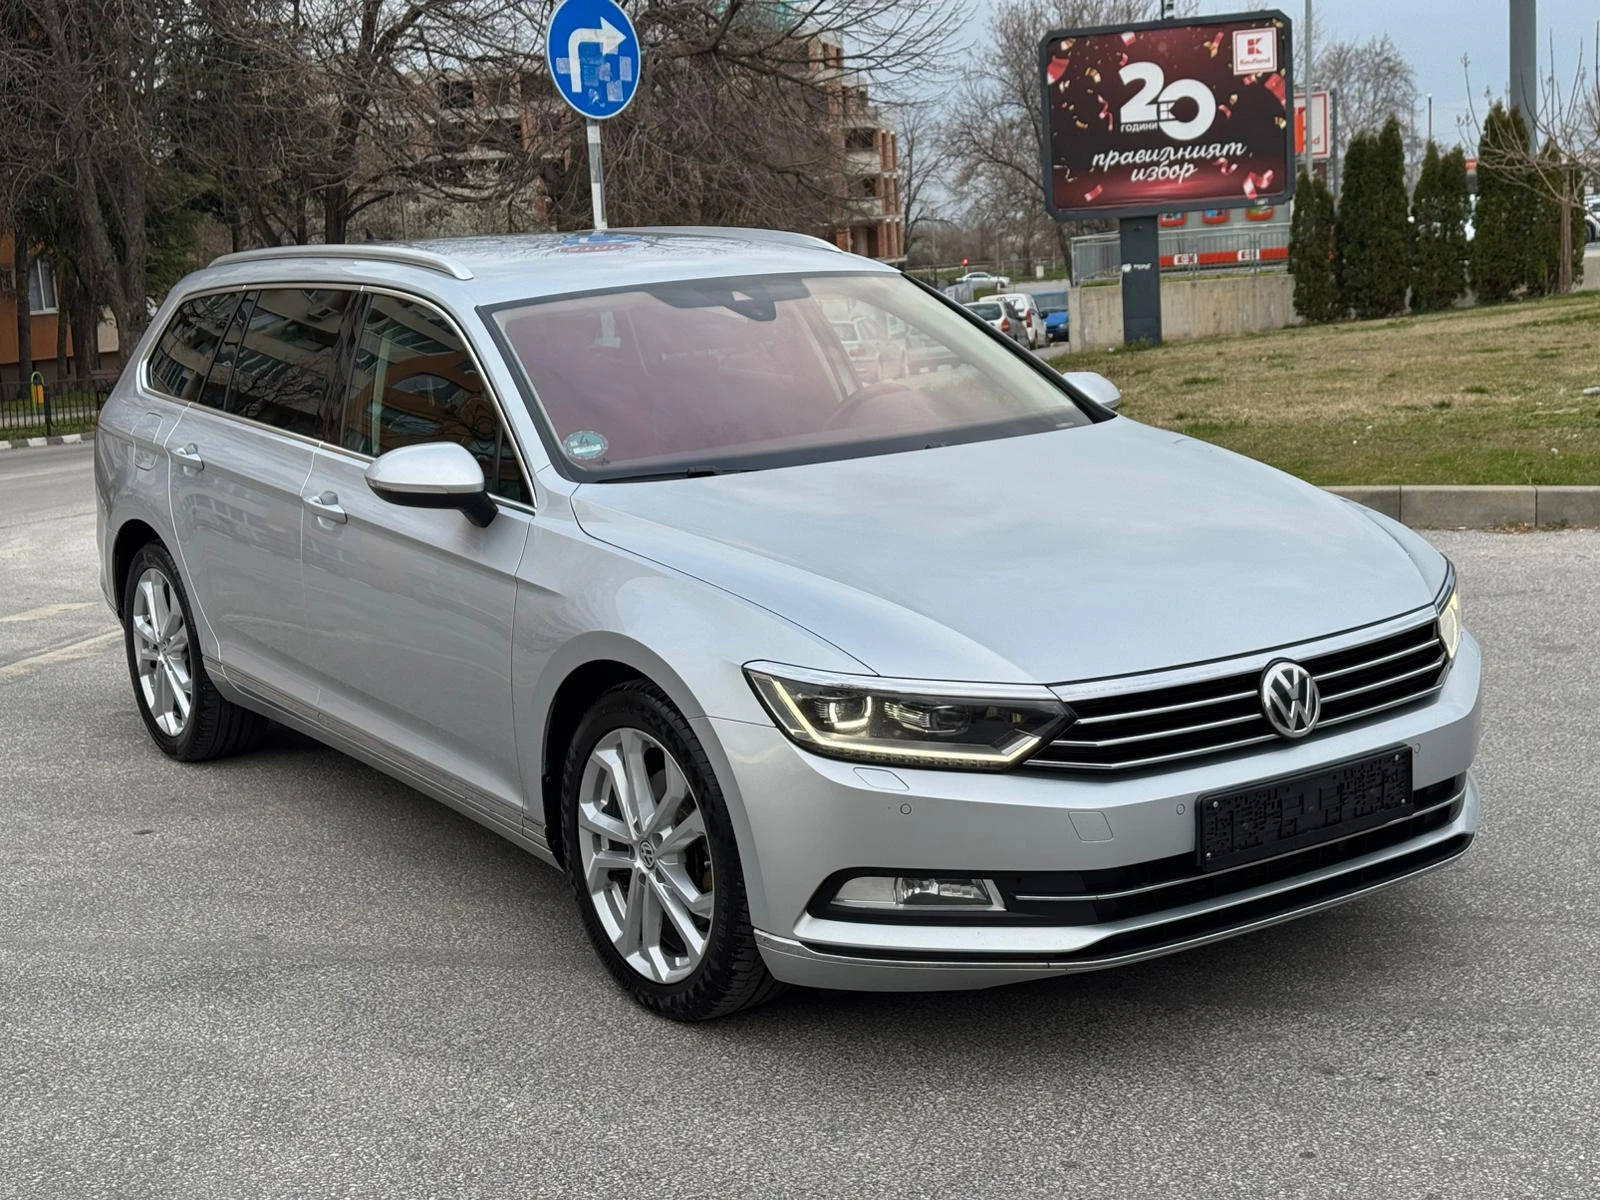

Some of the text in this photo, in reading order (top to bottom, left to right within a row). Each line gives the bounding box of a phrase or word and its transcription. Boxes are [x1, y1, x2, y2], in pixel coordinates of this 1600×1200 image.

[1118, 61, 1216, 141] 20
[1120, 122, 1158, 133] години
[1091, 141, 1248, 172] правилният
[1130, 160, 1198, 184] избор
